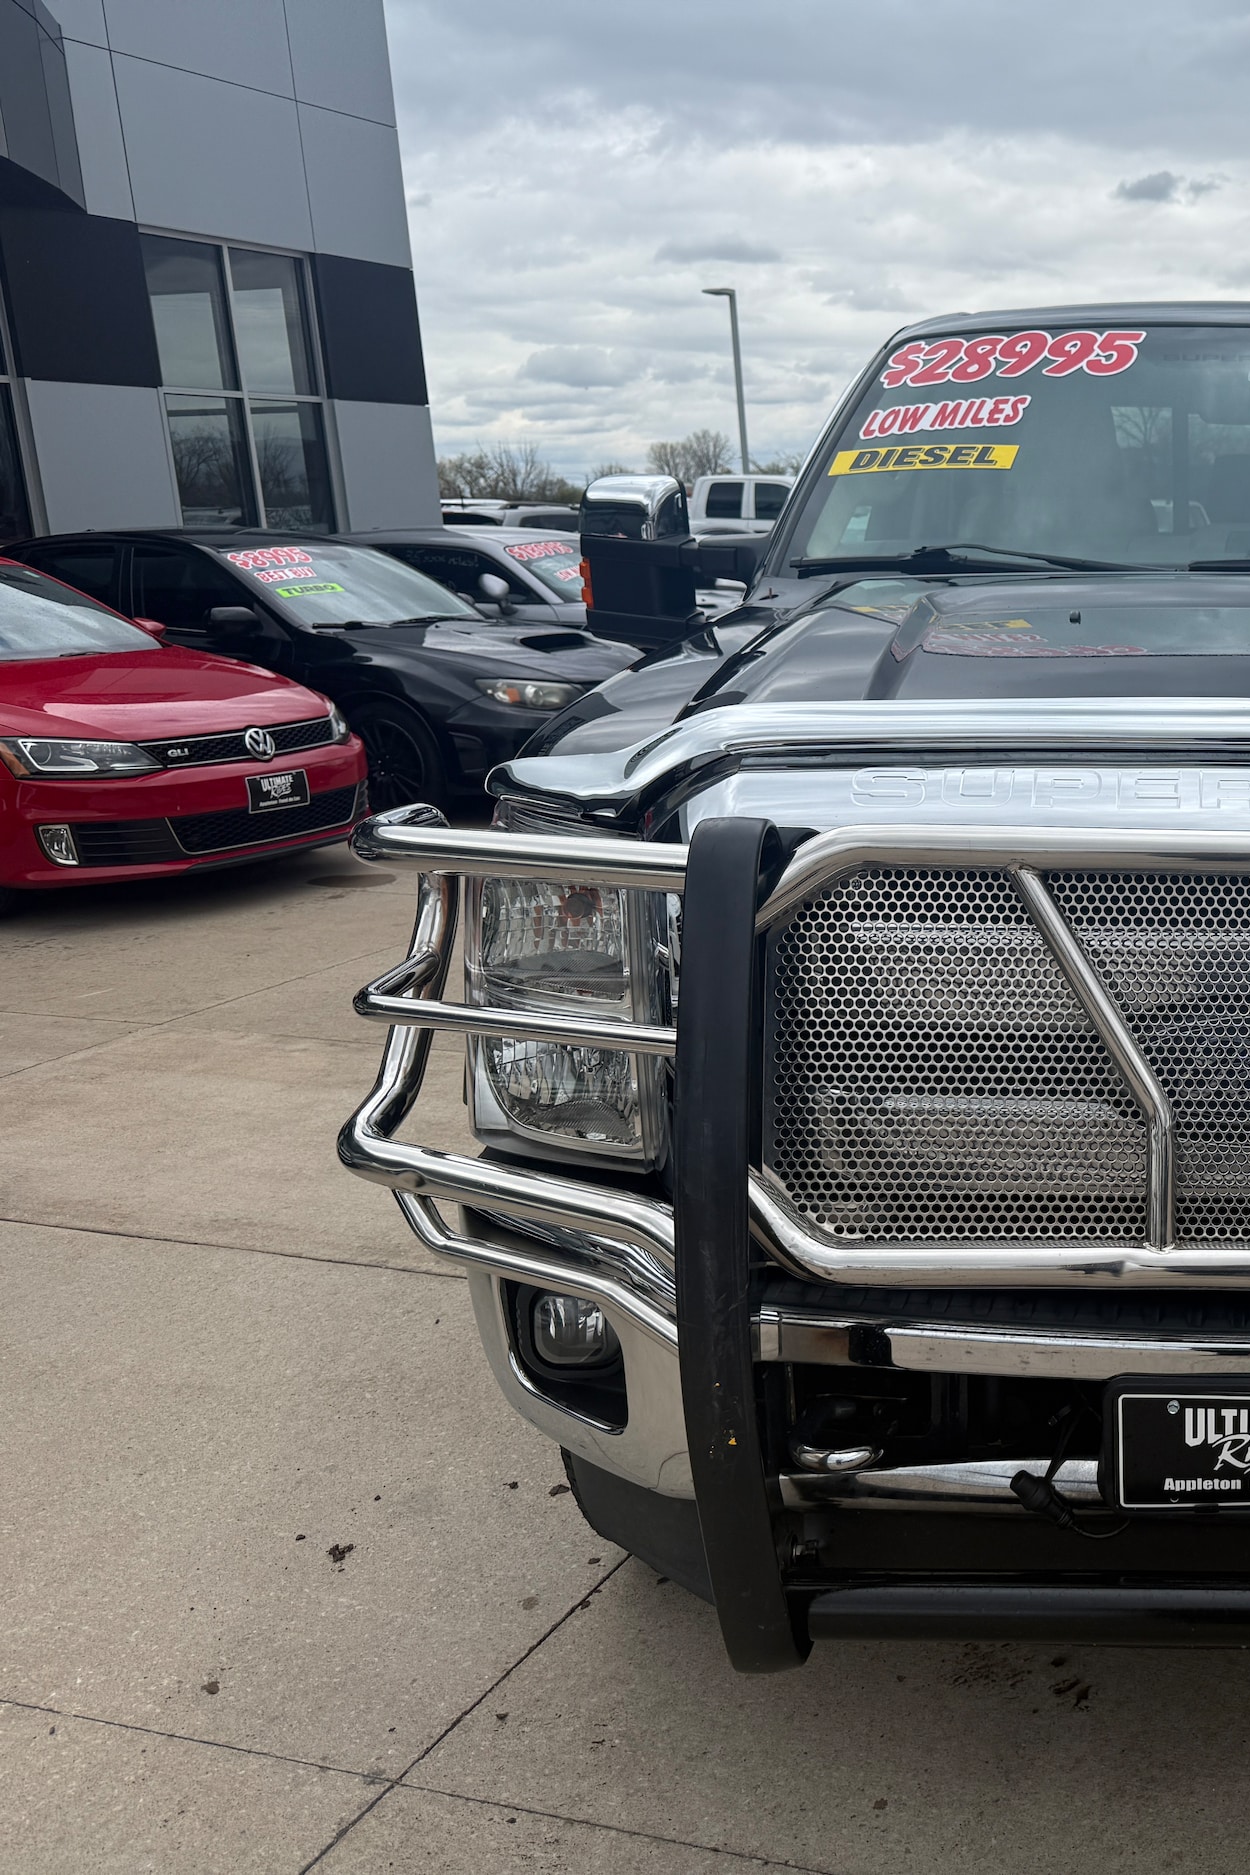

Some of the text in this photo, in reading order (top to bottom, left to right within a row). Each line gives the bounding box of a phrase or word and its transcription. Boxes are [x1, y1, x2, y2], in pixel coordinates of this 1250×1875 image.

[880, 331, 1146, 388] $28995
[860, 395, 1031, 439] LOW MILES
[849, 446, 998, 471] DIESEL
[227, 546, 312, 569] $8995
[254, 566, 317, 583] BEST BUY
[282, 583, 336, 595] TURBO
[167, 748, 190, 757] GLI
[260, 774, 294, 793] ULTIMATE
[1163, 1477, 1242, 1492] Appleton
